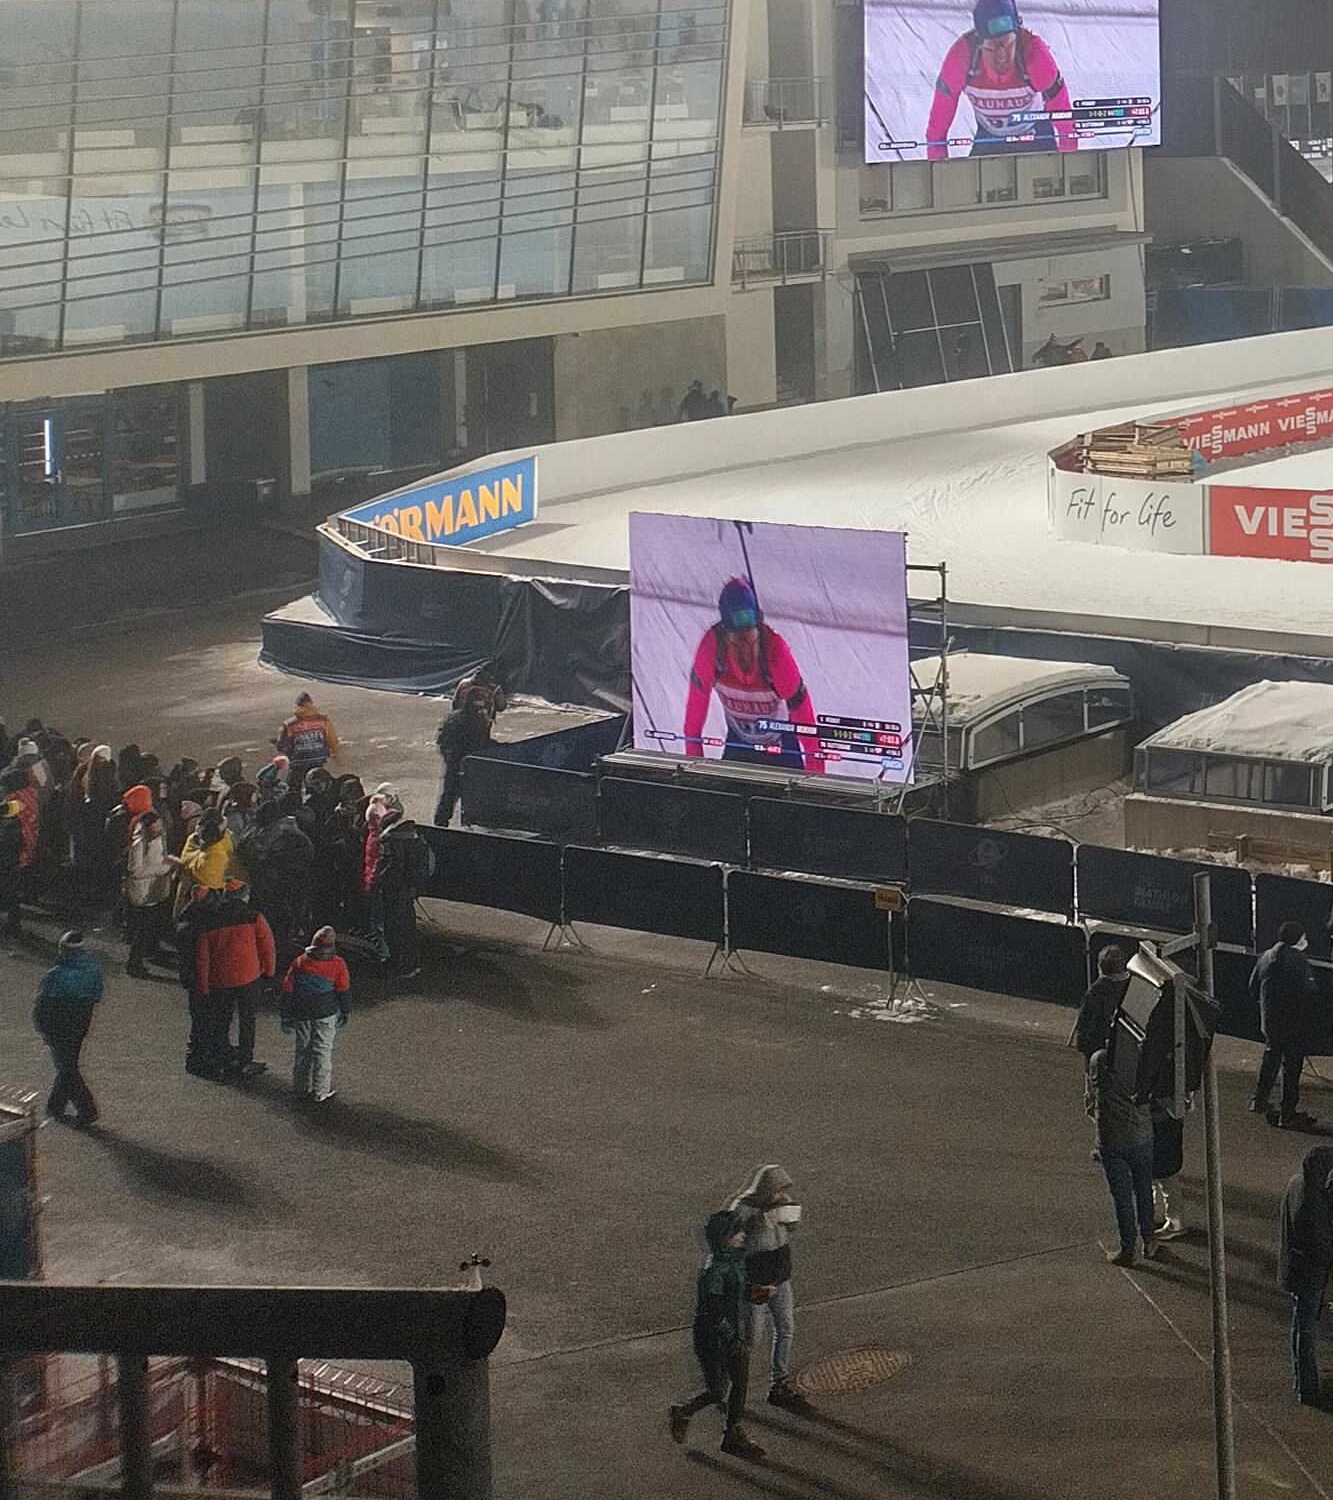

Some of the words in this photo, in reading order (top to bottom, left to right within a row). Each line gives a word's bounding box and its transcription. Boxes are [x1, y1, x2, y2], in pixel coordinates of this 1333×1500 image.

[368, 473, 522, 542] ÖRMANN
[1065, 487, 1096, 521] Fit
[1101, 491, 1131, 532] for
[1137, 491, 1177, 537] life
[758, 720, 768, 730] 75
